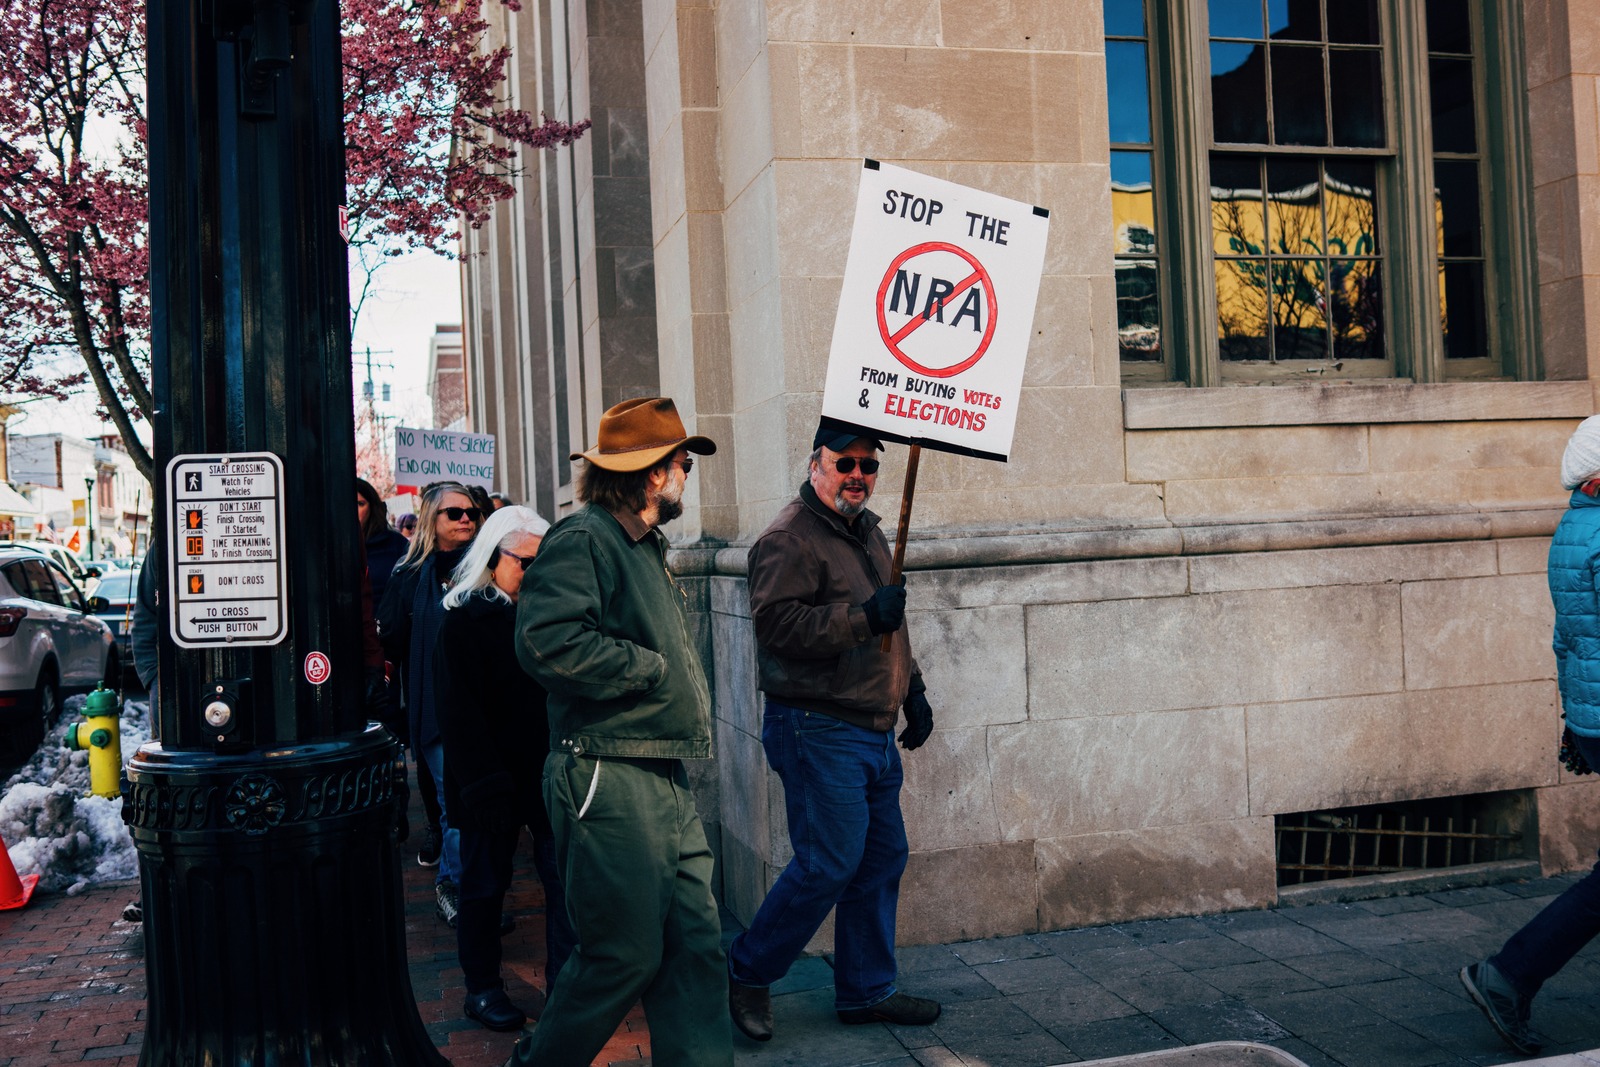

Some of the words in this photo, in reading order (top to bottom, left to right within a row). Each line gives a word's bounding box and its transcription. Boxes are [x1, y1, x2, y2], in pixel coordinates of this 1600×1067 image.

[883, 189, 943, 226] STOP
[966, 211, 1010, 245] THE
[889, 269, 981, 333] NRA
[860, 367, 898, 388] FROM
[905, 377, 956, 399] BUYING
[963, 389, 1002, 410] VOTES
[858, 388, 869, 409] &
[884, 393, 987, 432] ELECTIONS
[399, 432, 414, 446] NO
[424, 434, 456, 452] MORE
[460, 436, 494, 454] SILENCE
[209, 465, 228, 474] START
[232, 464, 265, 473] CROSSING
[398, 457, 419, 473] END
[421, 460, 440, 475] GUN
[446, 461, 493, 479] VIOLENCE
[225, 487, 251, 496] Vehicles
[220, 503, 238, 512] DON'T
[242, 502, 261, 510] START
[217, 516, 234, 524] Finish
[239, 515, 264, 525] Crossing
[233, 525, 256, 534] Started
[213, 539, 227, 548] TIME
[233, 538, 270, 547] REMAINING
[211, 549, 218, 558] To
[223, 549, 242, 558] Finish
[246, 548, 272, 558] Crossing
[219, 576, 238, 585] DON'T
[242, 575, 264, 584] CROSS
[207, 608, 217, 617] TO
[222, 607, 249, 616] CROSS
[198, 624, 220, 633] PUSH
[226, 623, 258, 632] BUTTON
